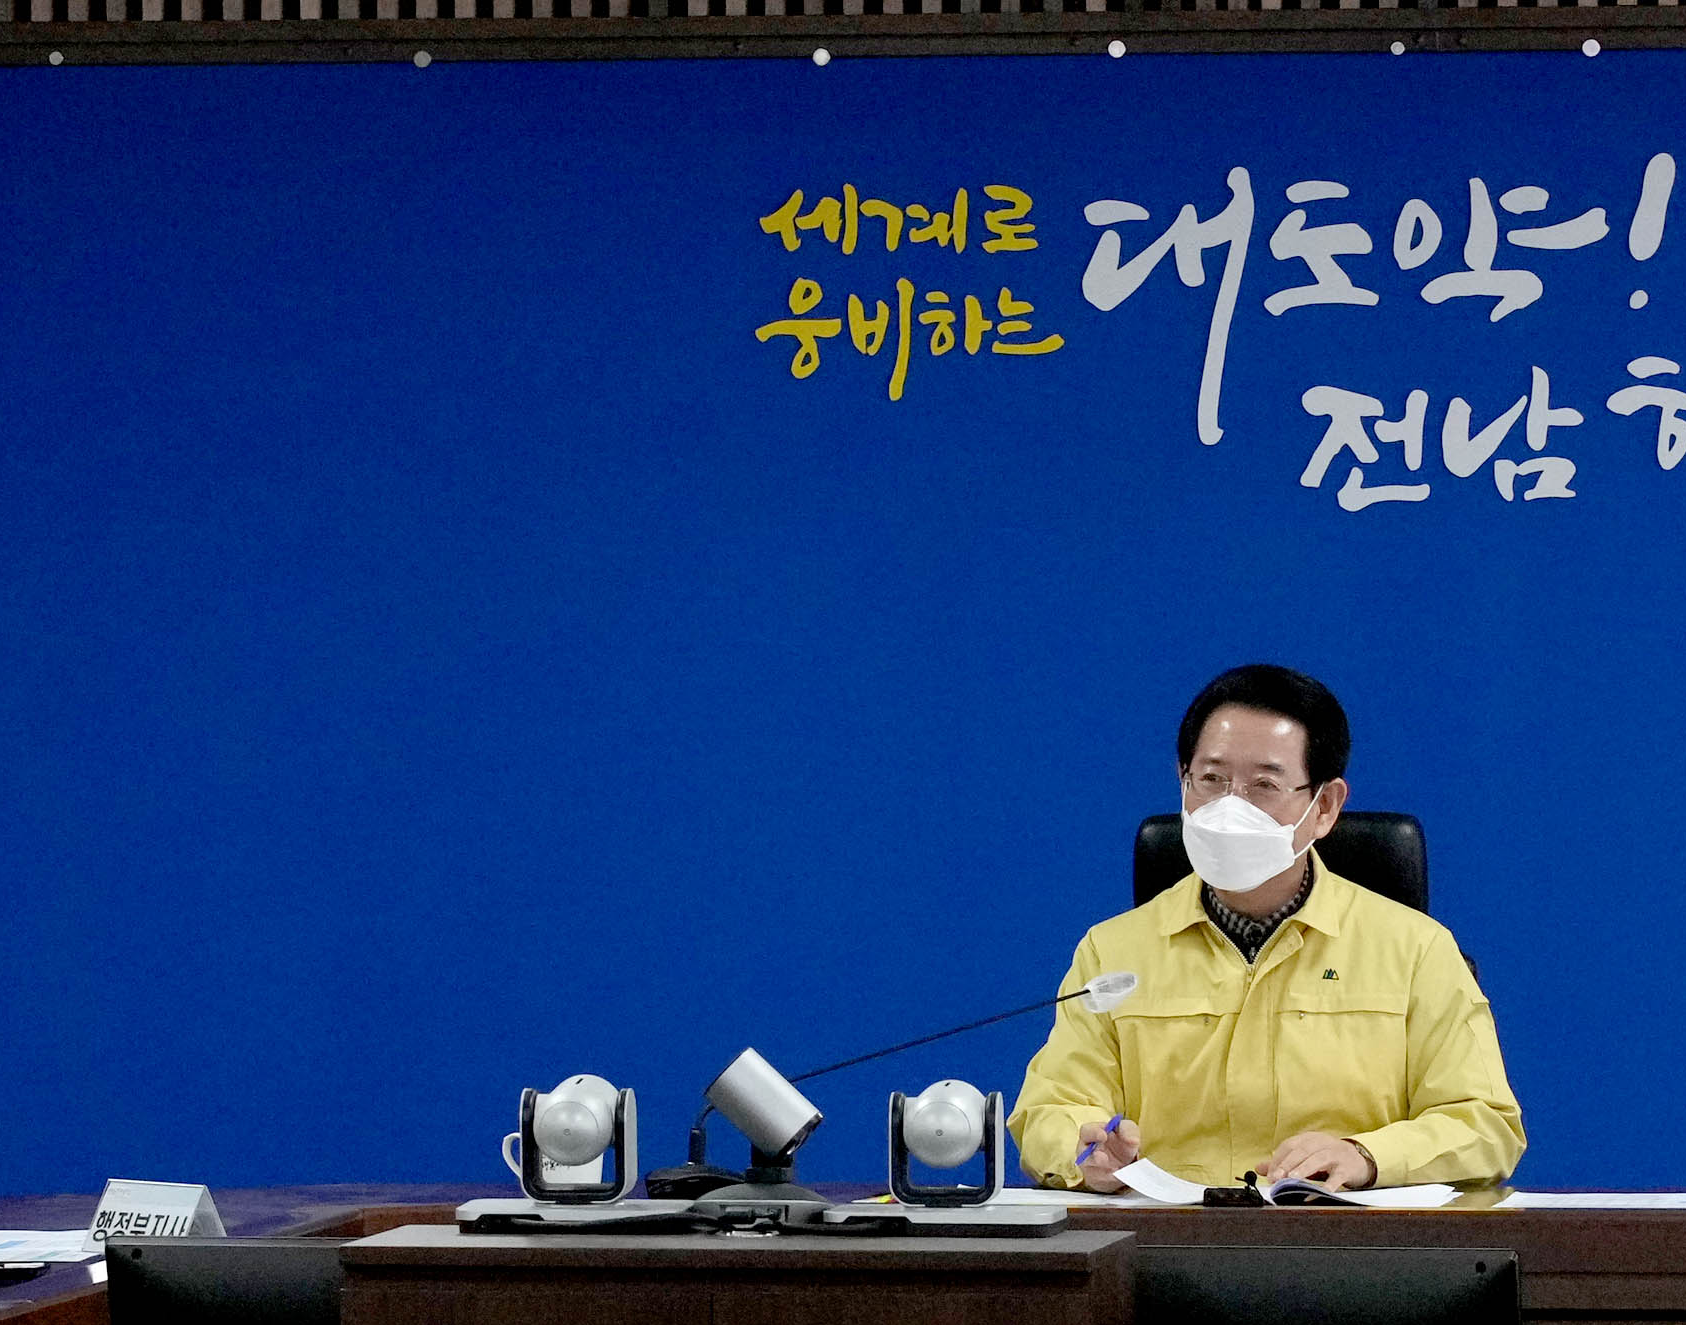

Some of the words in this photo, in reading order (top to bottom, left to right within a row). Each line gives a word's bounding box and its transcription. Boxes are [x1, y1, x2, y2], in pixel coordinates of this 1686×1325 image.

[760, 184, 1038, 254] 세계로
[755, 278, 1064, 400] 웅비하는
[1082, 153, 1675, 445] 대도약!
[1300, 366, 1583, 511] 전남
